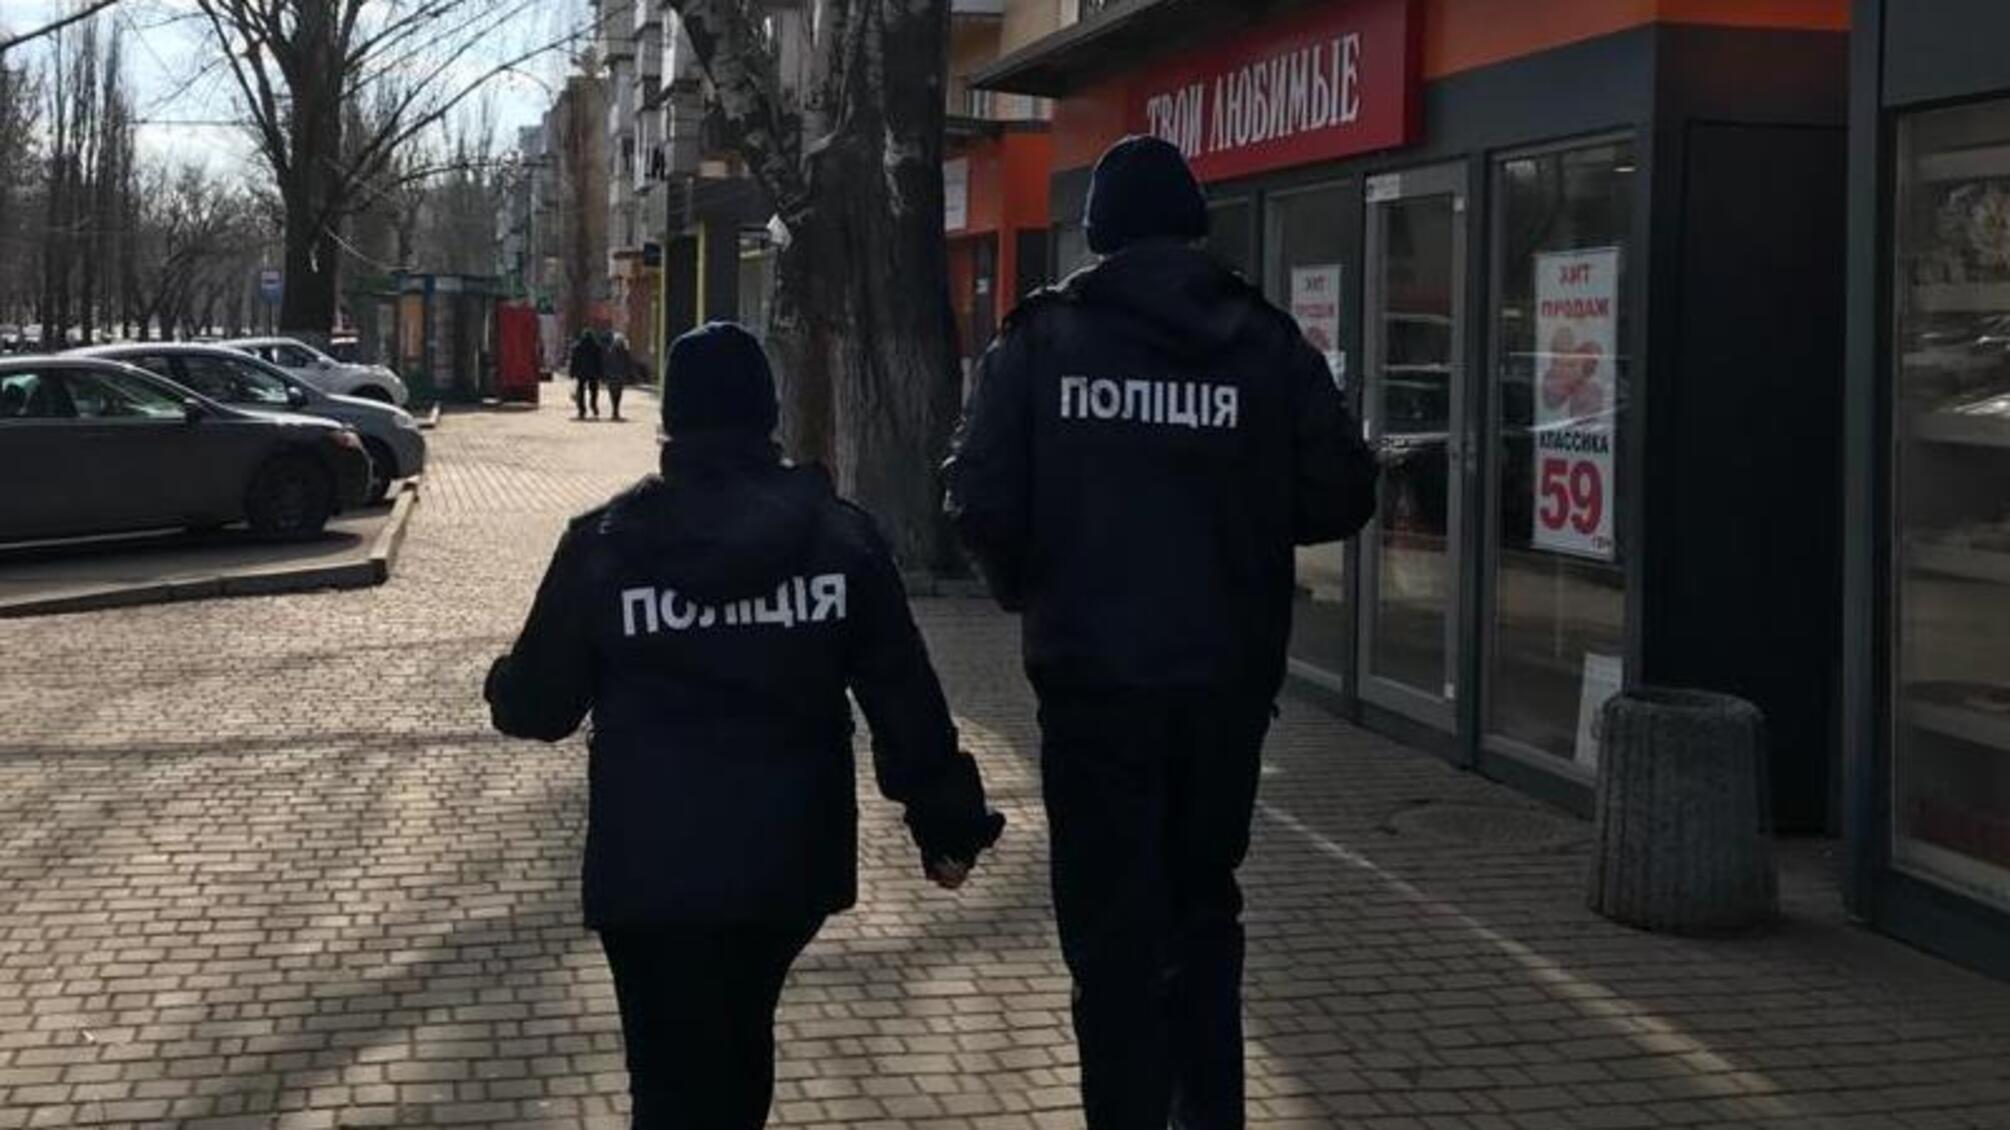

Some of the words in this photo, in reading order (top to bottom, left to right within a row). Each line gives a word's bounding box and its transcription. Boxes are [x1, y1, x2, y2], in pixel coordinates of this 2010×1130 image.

[1208, 32, 1360, 152] ЛЮБИМЫЕ
[1559, 263, 1591, 286] ХИТ
[1541, 297, 1608, 318] ПРОДАЖ
[1061, 376, 1238, 428] ПОЛІЦІЯ
[1539, 429, 1609, 454] КЛАССИКА
[1540, 458, 1602, 534] 59
